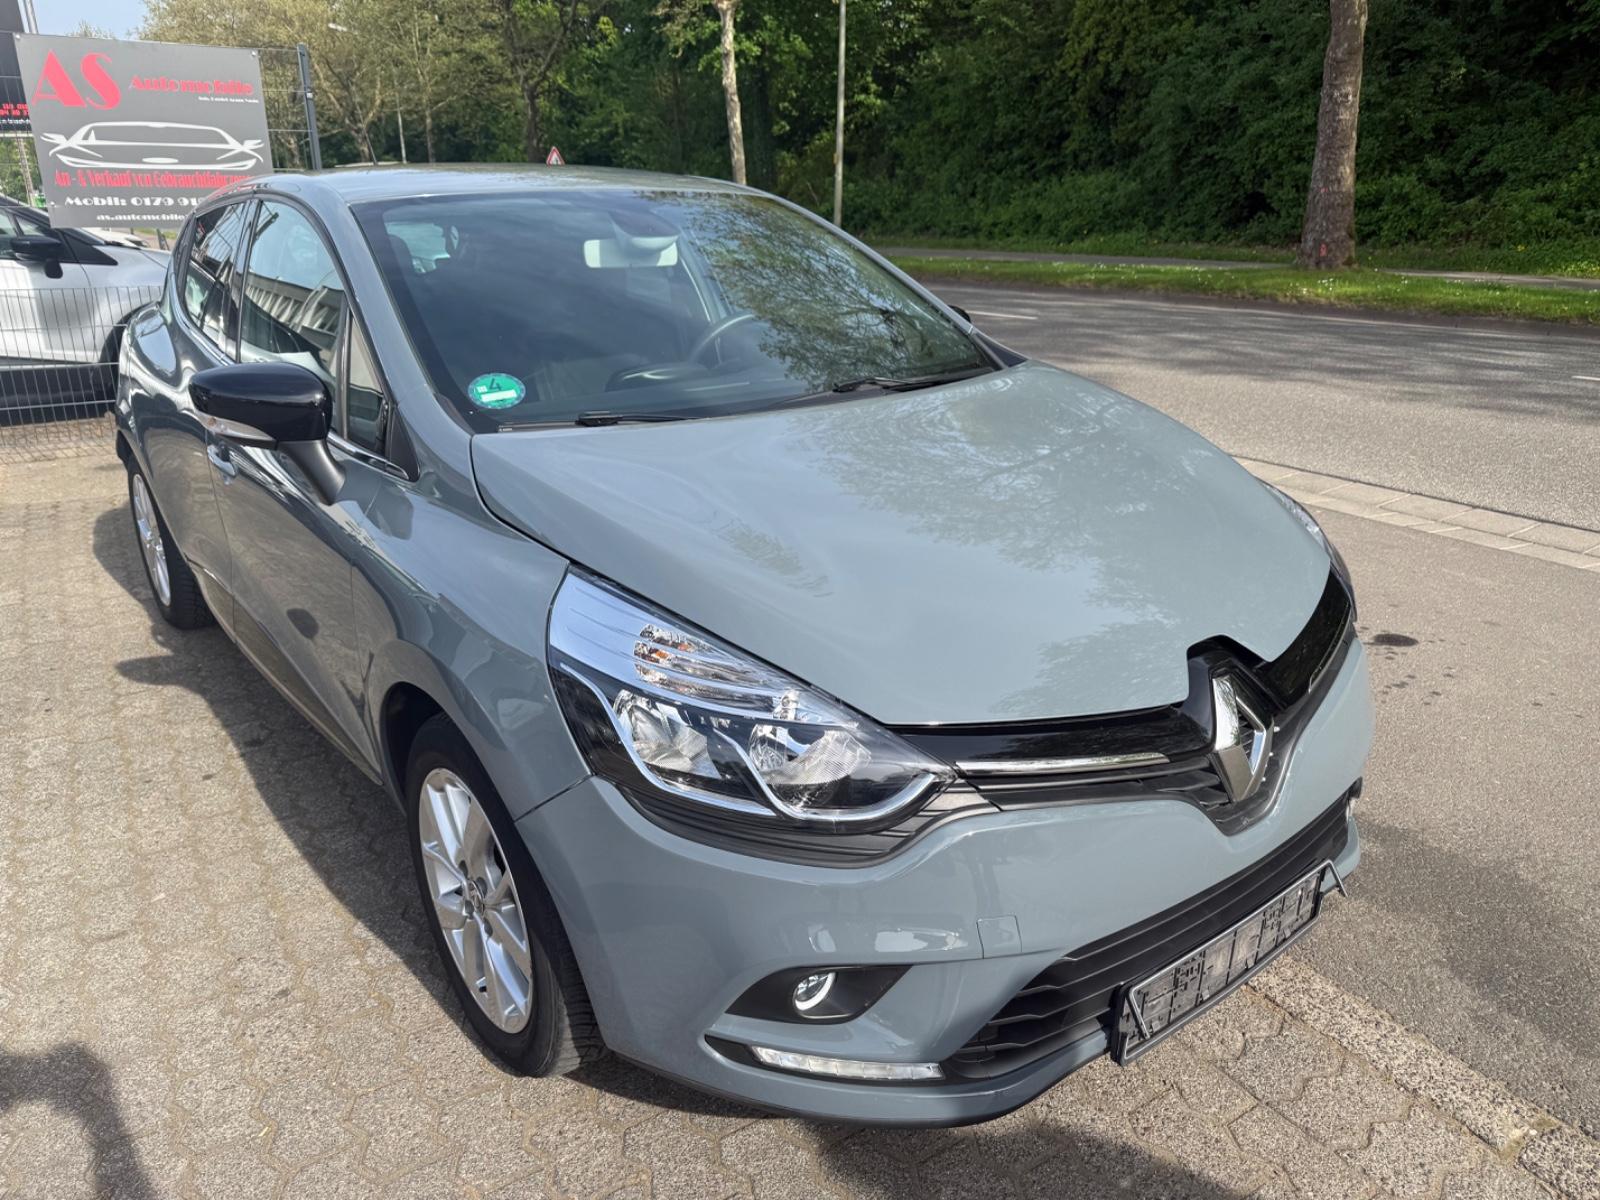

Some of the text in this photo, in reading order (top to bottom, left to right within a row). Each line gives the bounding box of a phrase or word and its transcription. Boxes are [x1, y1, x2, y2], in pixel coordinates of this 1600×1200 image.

[31, 49, 122, 109] AS
[87, 169, 131, 187] Verkauf
[65, 196, 127, 206] Mobil:
[131, 196, 174, 206] 0179
[488, 378, 502, 390] 4
